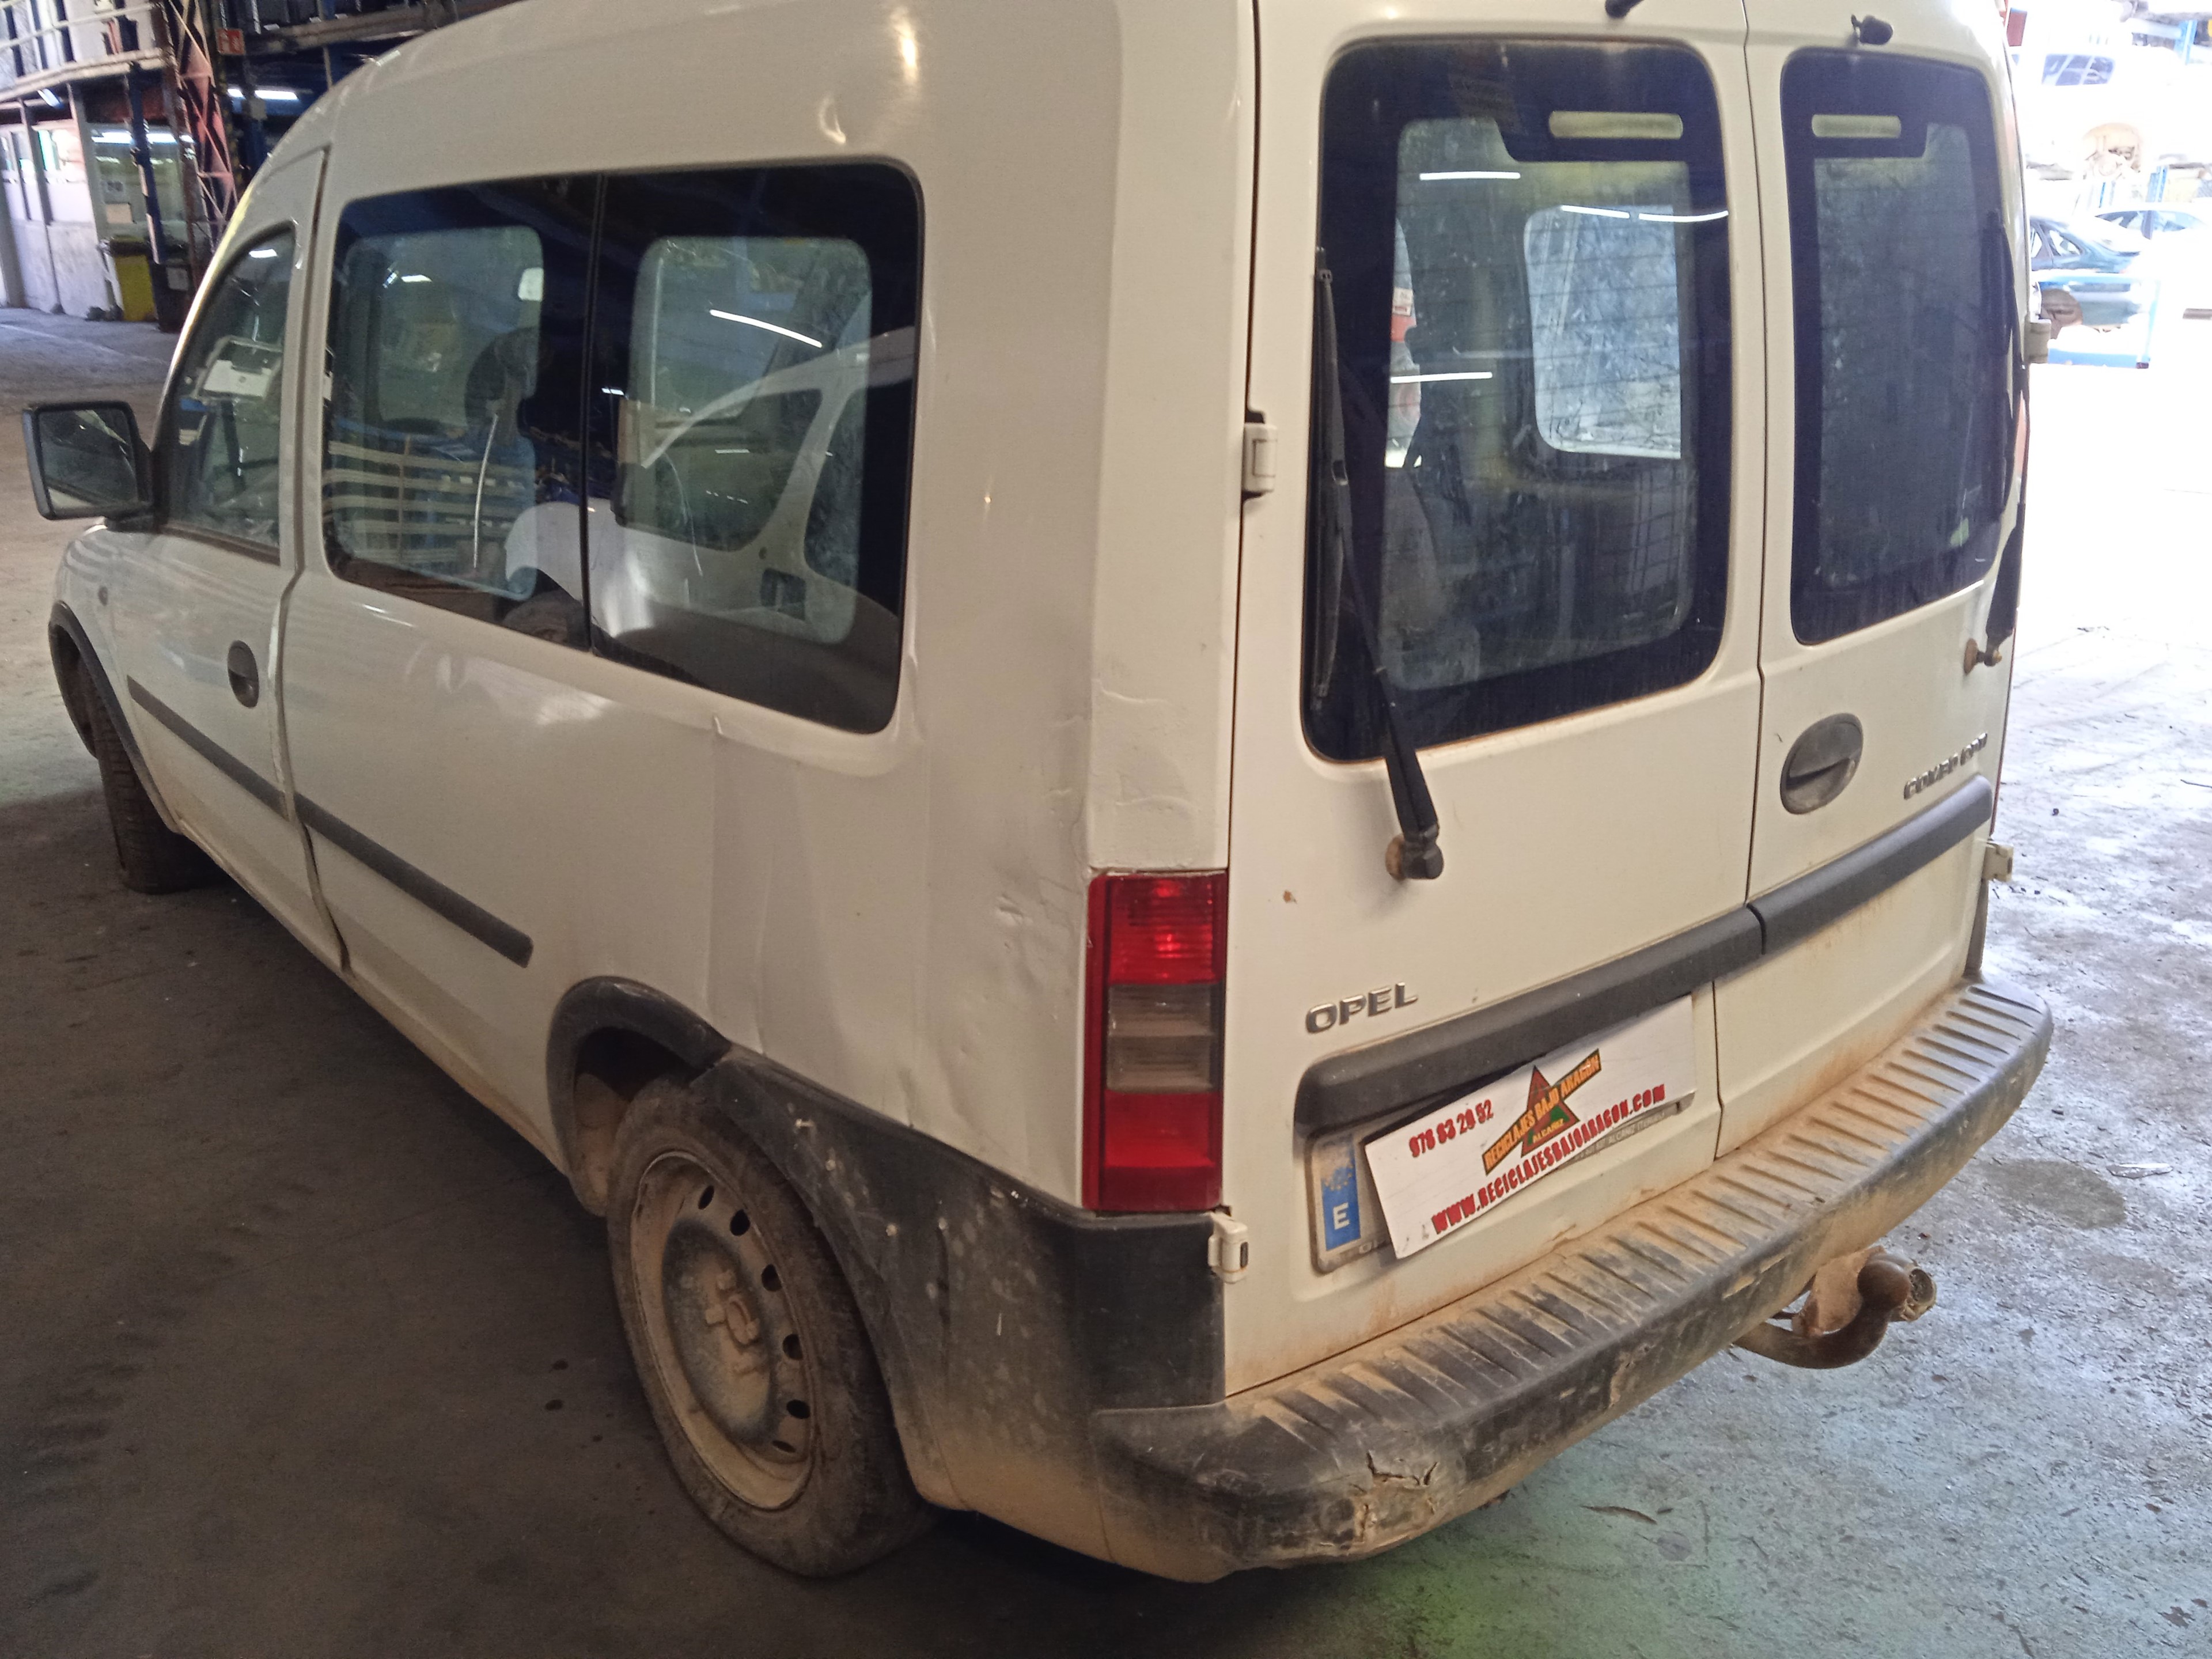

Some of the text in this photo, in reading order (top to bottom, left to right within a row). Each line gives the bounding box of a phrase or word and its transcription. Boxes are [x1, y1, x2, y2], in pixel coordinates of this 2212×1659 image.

[1305, 982, 1419, 1034] OPEL
[1475, 1099, 1494, 1124] 52
[1534, 1087, 1560, 1121] BAJO
[1430, 1084, 1666, 1234] WWW.RECICLAJESBAJOARAGON.COM
[1333, 1202, 1350, 1230] E
